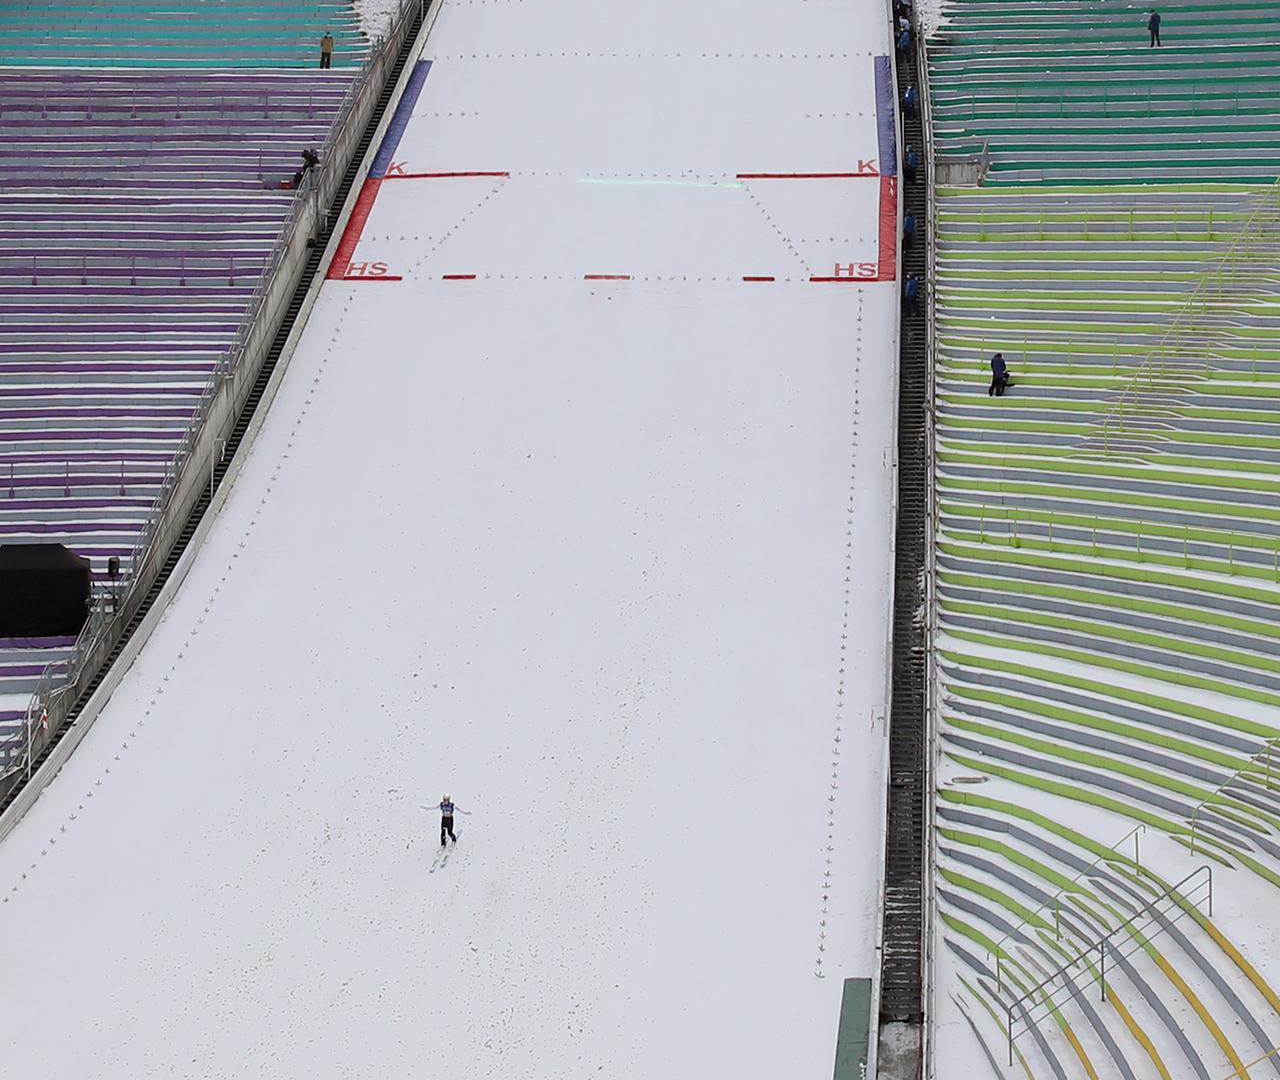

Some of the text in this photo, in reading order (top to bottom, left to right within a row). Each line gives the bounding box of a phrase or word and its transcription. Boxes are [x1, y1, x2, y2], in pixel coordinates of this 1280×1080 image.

[387, 161, 409, 174] K
[858, 159, 878, 172] K
[346, 262, 388, 275] HS
[834, 263, 876, 276] HS
